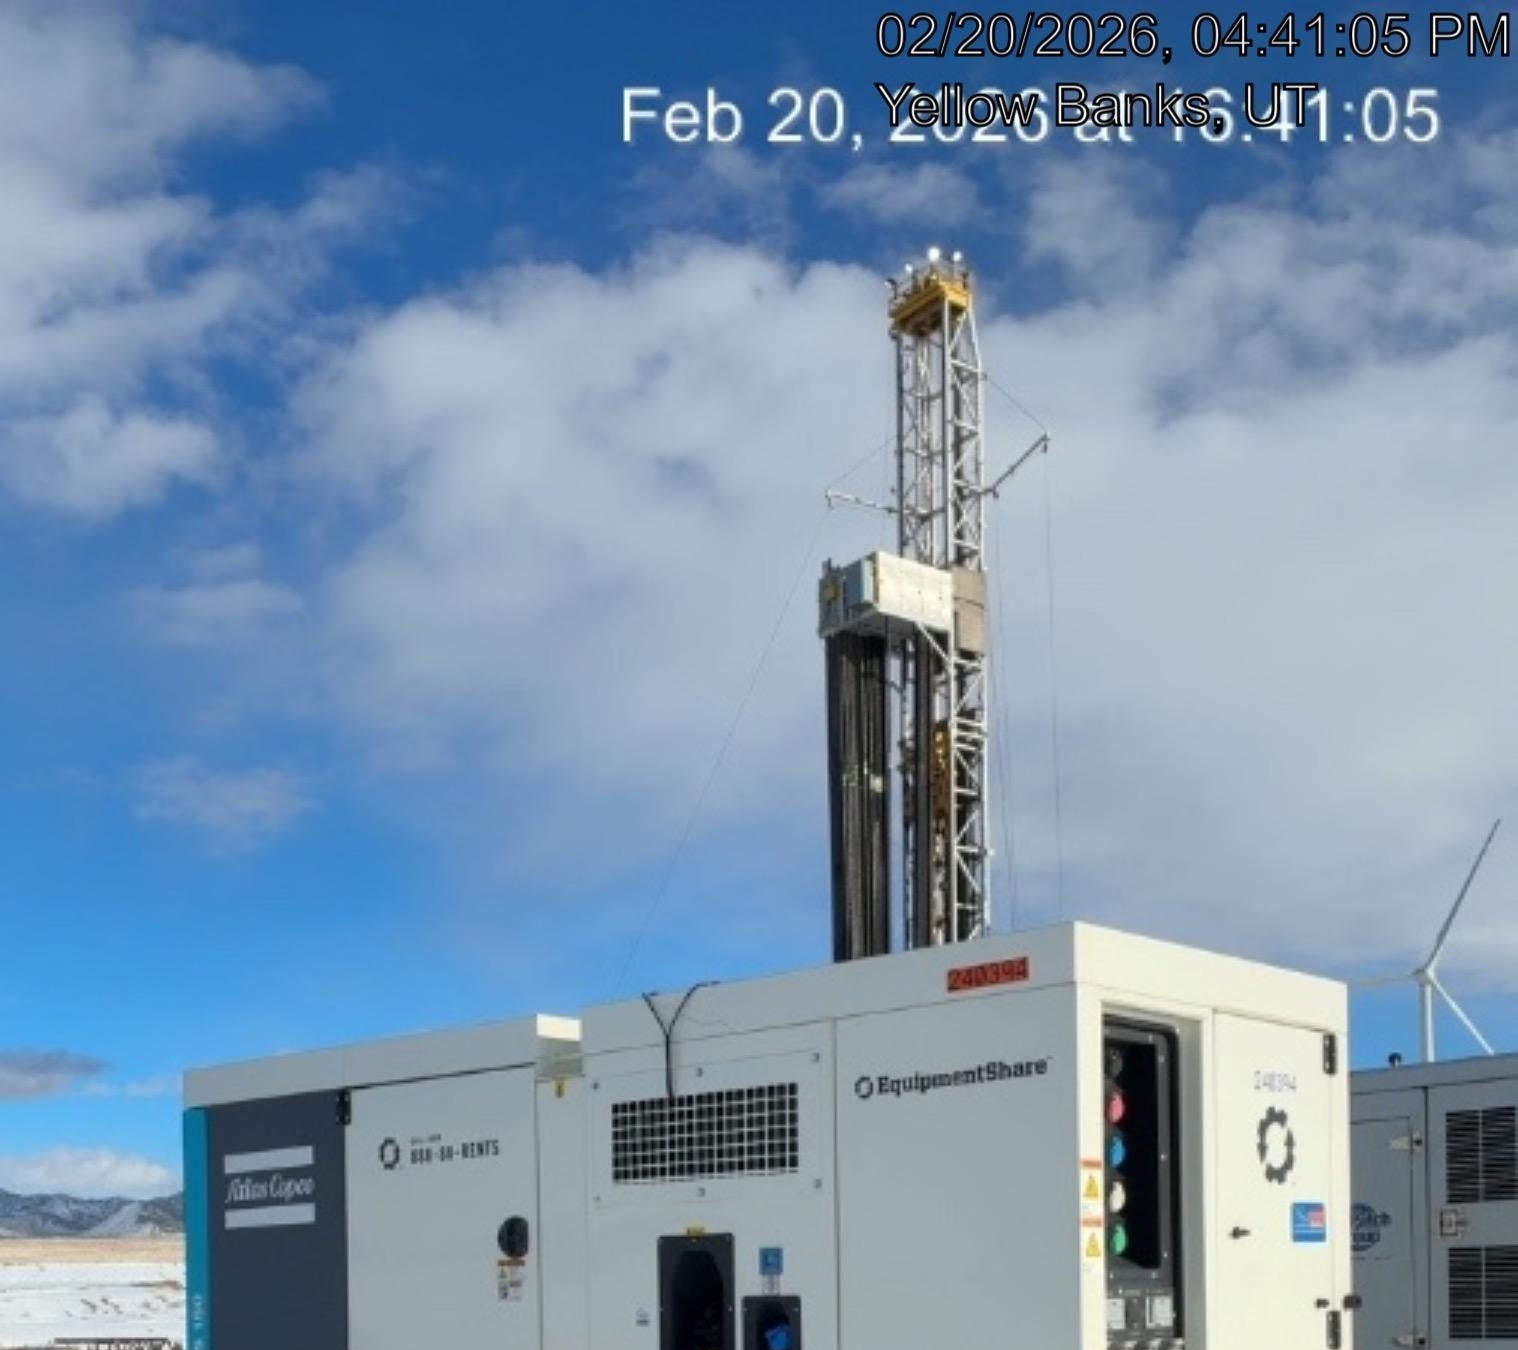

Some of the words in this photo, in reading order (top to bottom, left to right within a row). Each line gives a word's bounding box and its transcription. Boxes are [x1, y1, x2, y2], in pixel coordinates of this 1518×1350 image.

[948, 957, 1029, 991] 240394
[878, 1058, 1048, 1098] EquipmentShare
[224, 1177, 268, 1204] Atlas
[269, 1173, 315, 1202] Copco
